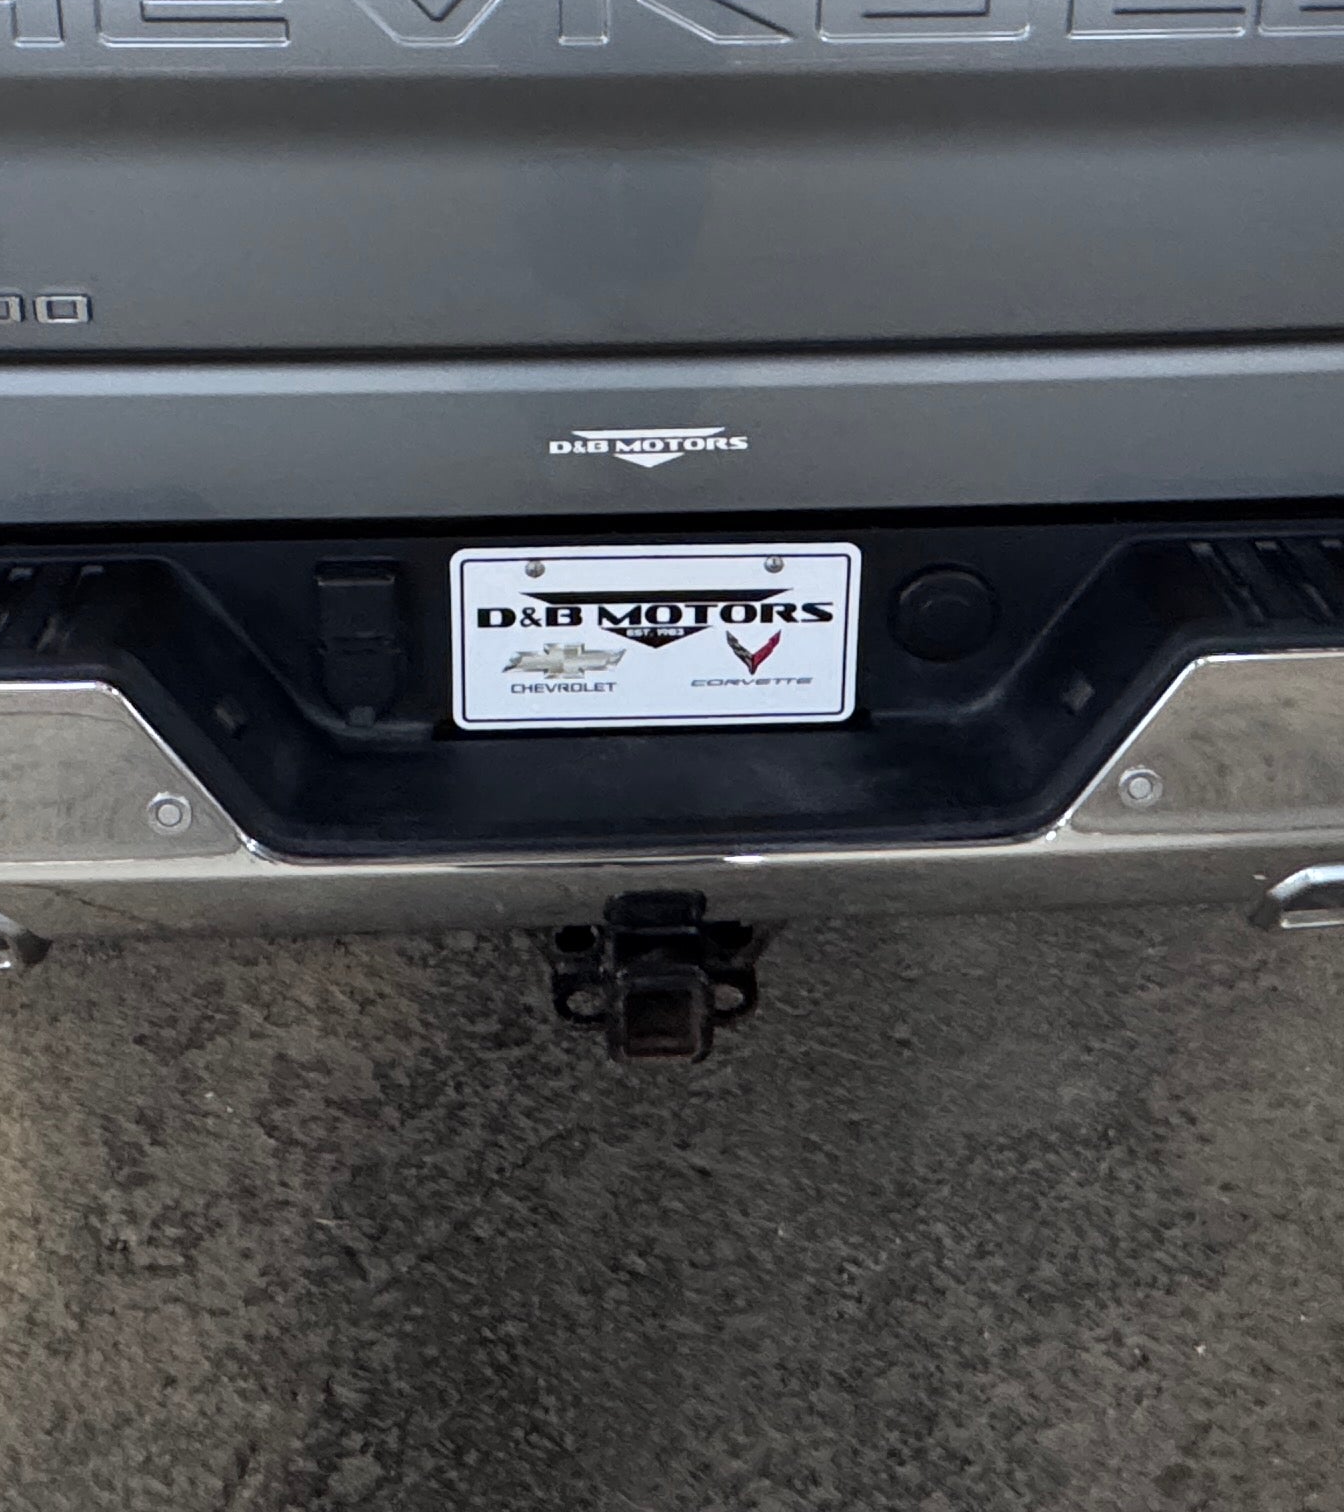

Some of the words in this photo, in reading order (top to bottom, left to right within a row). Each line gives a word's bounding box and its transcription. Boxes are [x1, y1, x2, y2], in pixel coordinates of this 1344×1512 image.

[549, 440, 609, 454] D&B
[615, 436, 748, 452] MOTORS
[477, 605, 583, 628] D&B
[598, 602, 834, 626] MOTORS
[510, 682, 617, 694] CHEVROLET
[690, 677, 813, 688] CORVETTE
